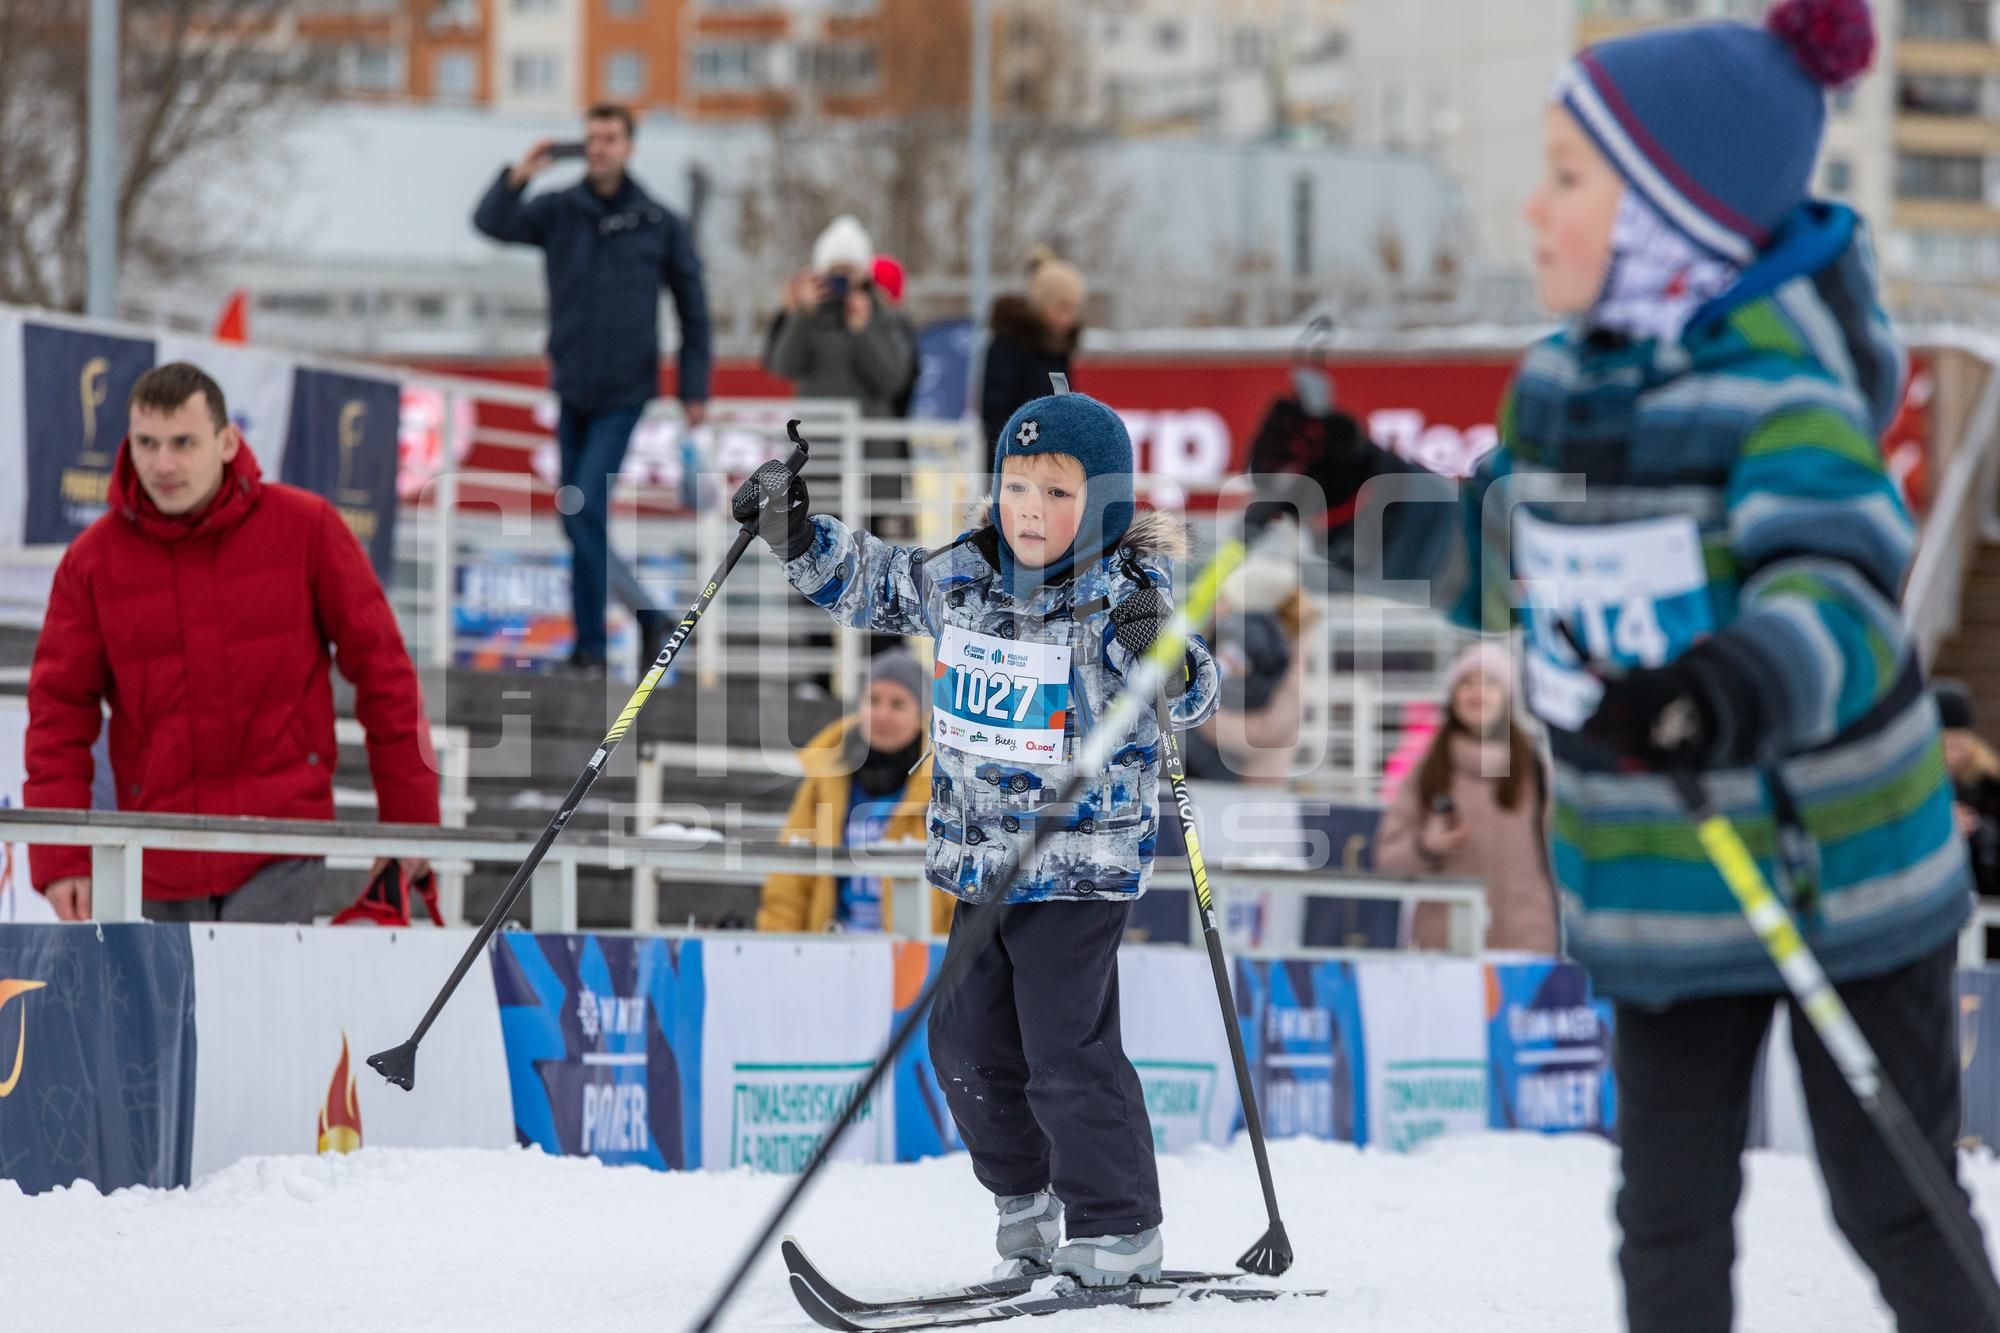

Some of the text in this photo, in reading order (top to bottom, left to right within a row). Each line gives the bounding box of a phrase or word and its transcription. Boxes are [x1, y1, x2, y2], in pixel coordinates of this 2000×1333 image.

[703, 582, 717, 600] 100
[1007, 653, 1029, 661] РОДНЫЕ
[1007, 660, 1027, 668] ГОРОДА
[954, 664, 1039, 723] 1027
